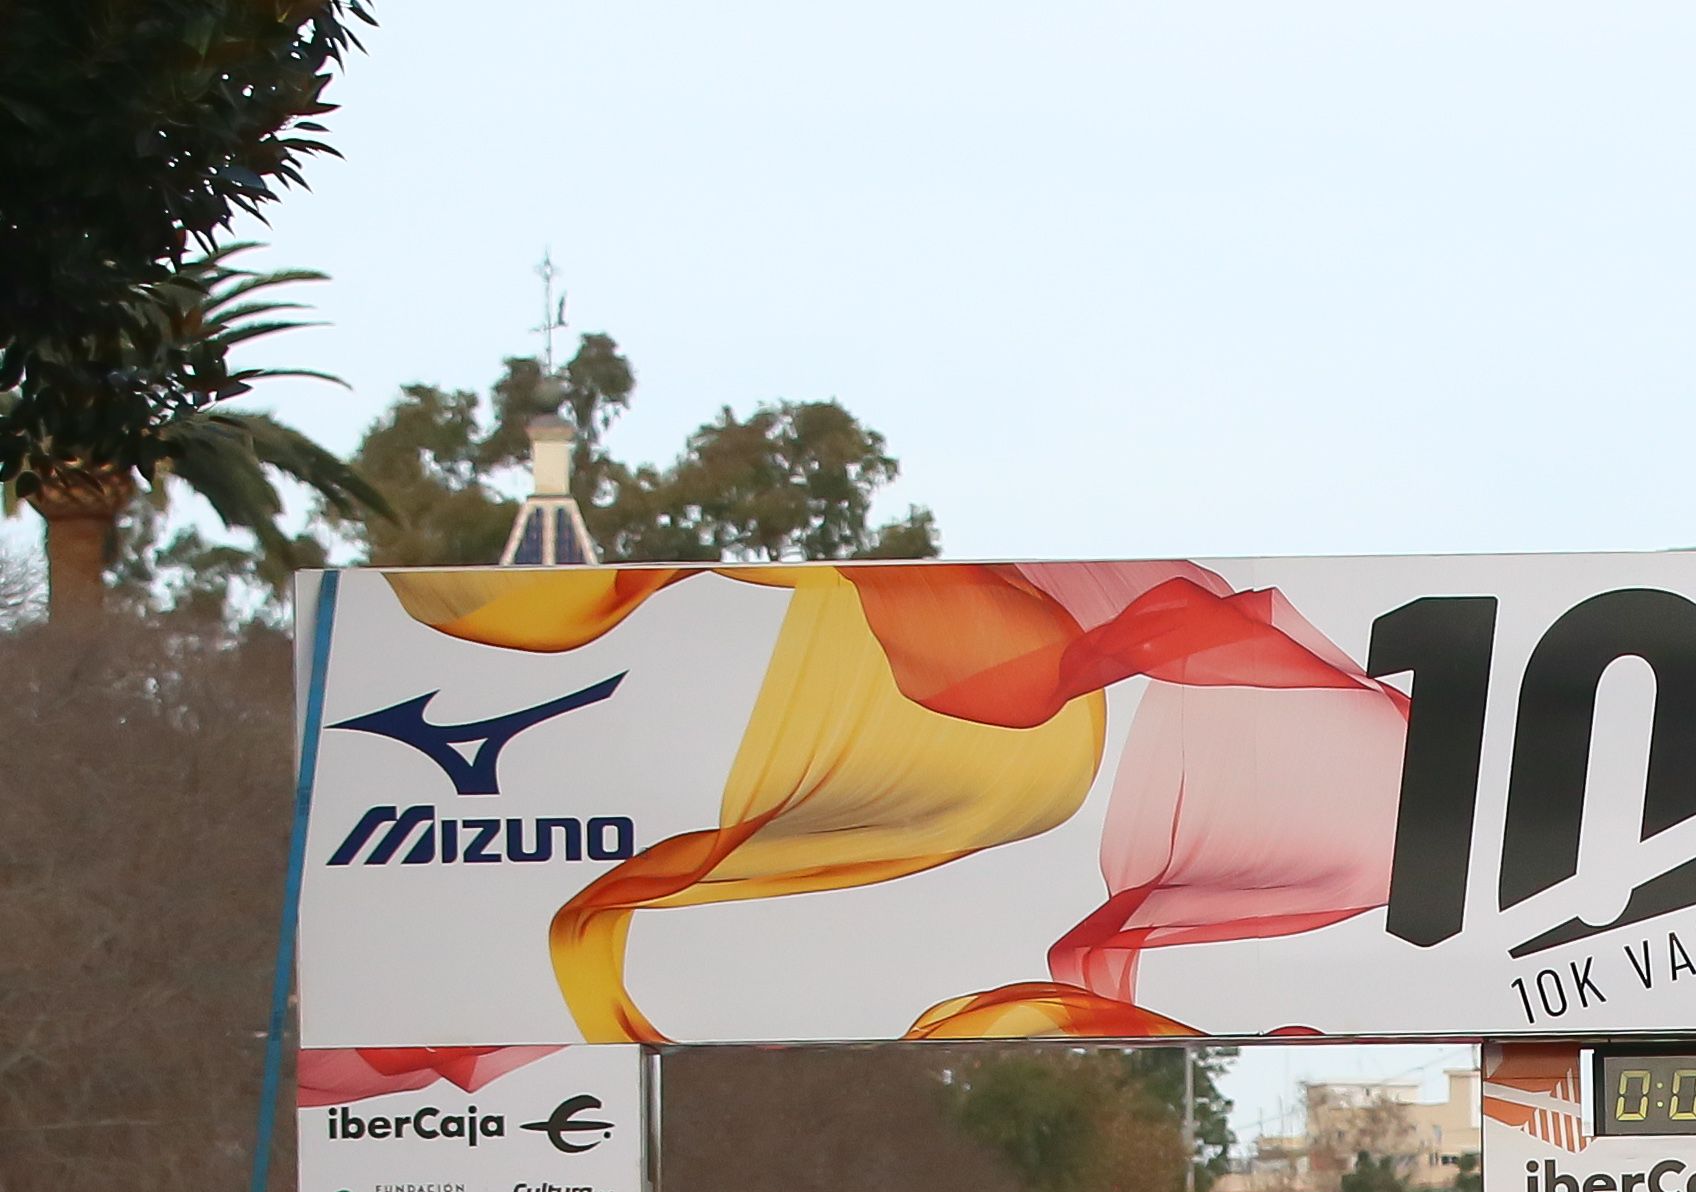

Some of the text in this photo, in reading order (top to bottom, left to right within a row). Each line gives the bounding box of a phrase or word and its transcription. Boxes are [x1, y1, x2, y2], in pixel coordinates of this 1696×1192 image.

[325, 805, 635, 866] MIZUNO
[1510, 957, 1607, 1025] 10K
[328, 1105, 506, 1147] iberCaja
